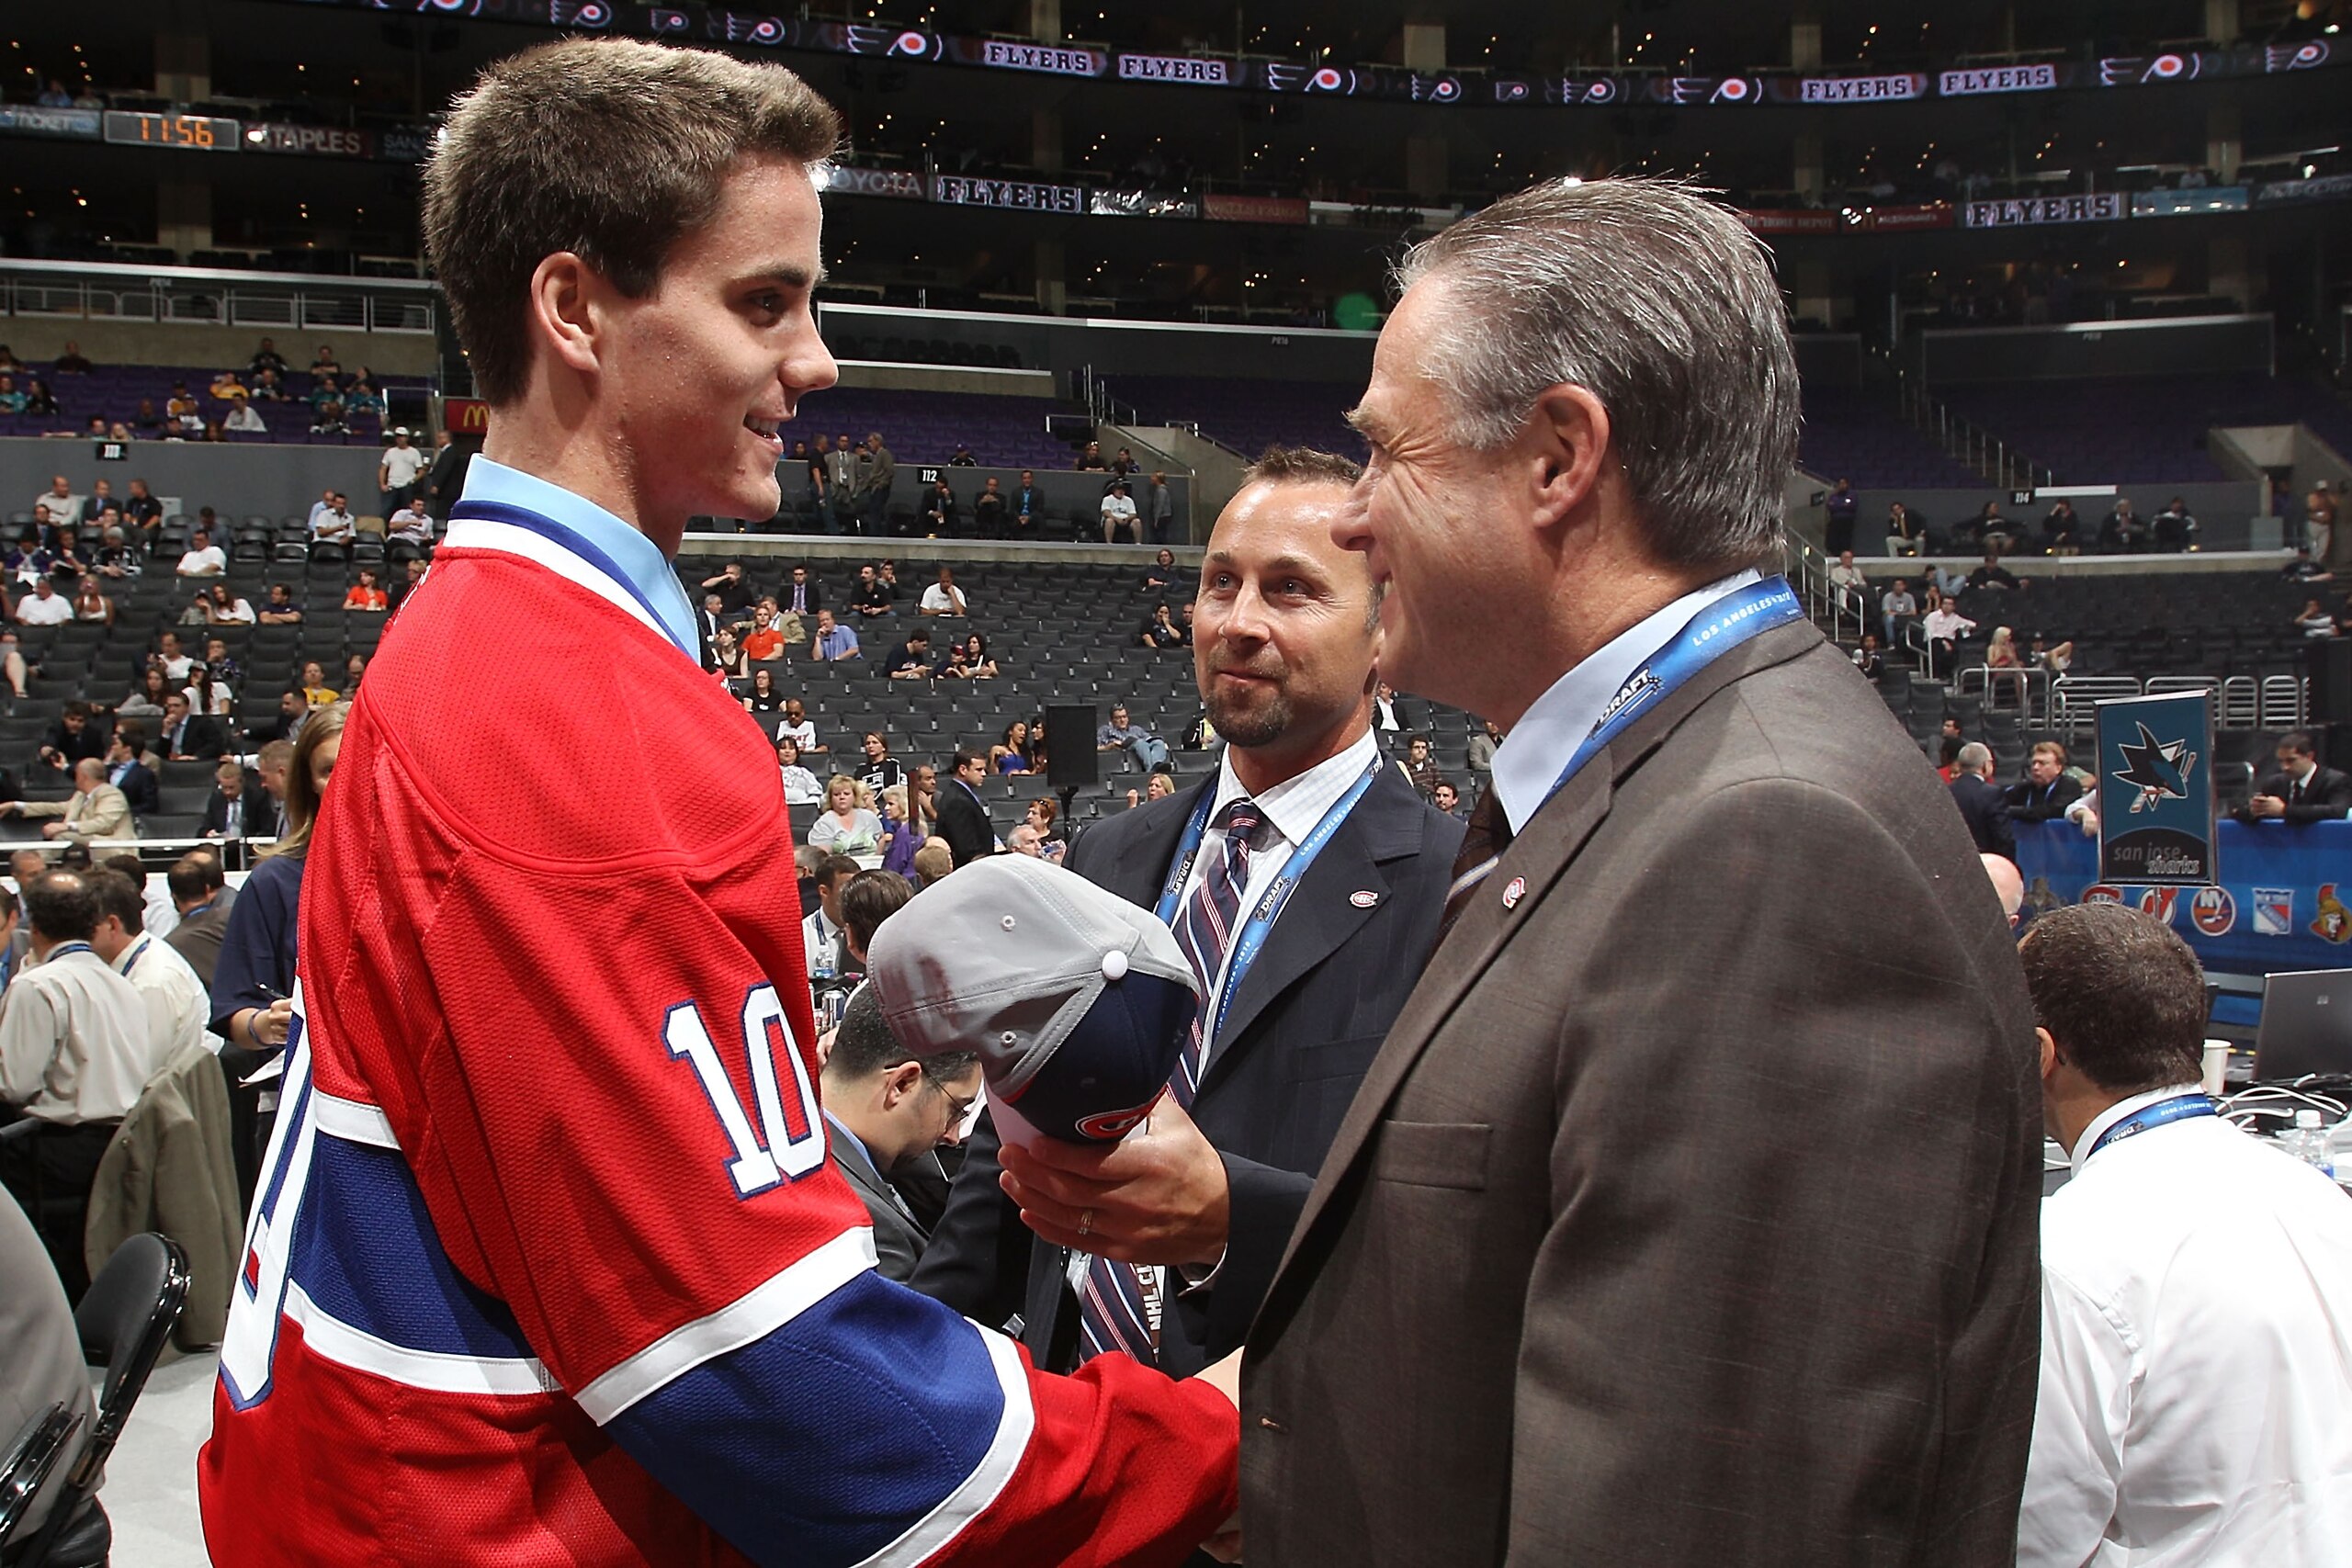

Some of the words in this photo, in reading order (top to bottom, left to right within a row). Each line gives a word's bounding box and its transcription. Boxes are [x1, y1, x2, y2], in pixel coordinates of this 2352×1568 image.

[987, 43, 1091, 73] FLYERS
[1122, 57, 1227, 82] FLYERS
[1804, 77, 1909, 100] FLYERS
[1944, 66, 2052, 93] FLYERS
[831, 169, 923, 195] OYOTA
[940, 175, 1079, 213] FLYERS
[1971, 196, 2114, 225] FLYERS
[922, 469, 937, 482] 112
[1692, 625, 1720, 647] LOS
[1723, 597, 1772, 628] ANGELES
[1600, 668, 1649, 724] DRAFT
[1313, 812, 1343, 842] ANGELES
[2113, 846, 2143, 861] san
[2147, 855, 2200, 874] sharks
[1261, 875, 1284, 912] DRAFT
[1238, 942, 1250, 962] 2010
[660, 979, 826, 1201] 10
[1143, 1287, 1162, 1330] NHL
